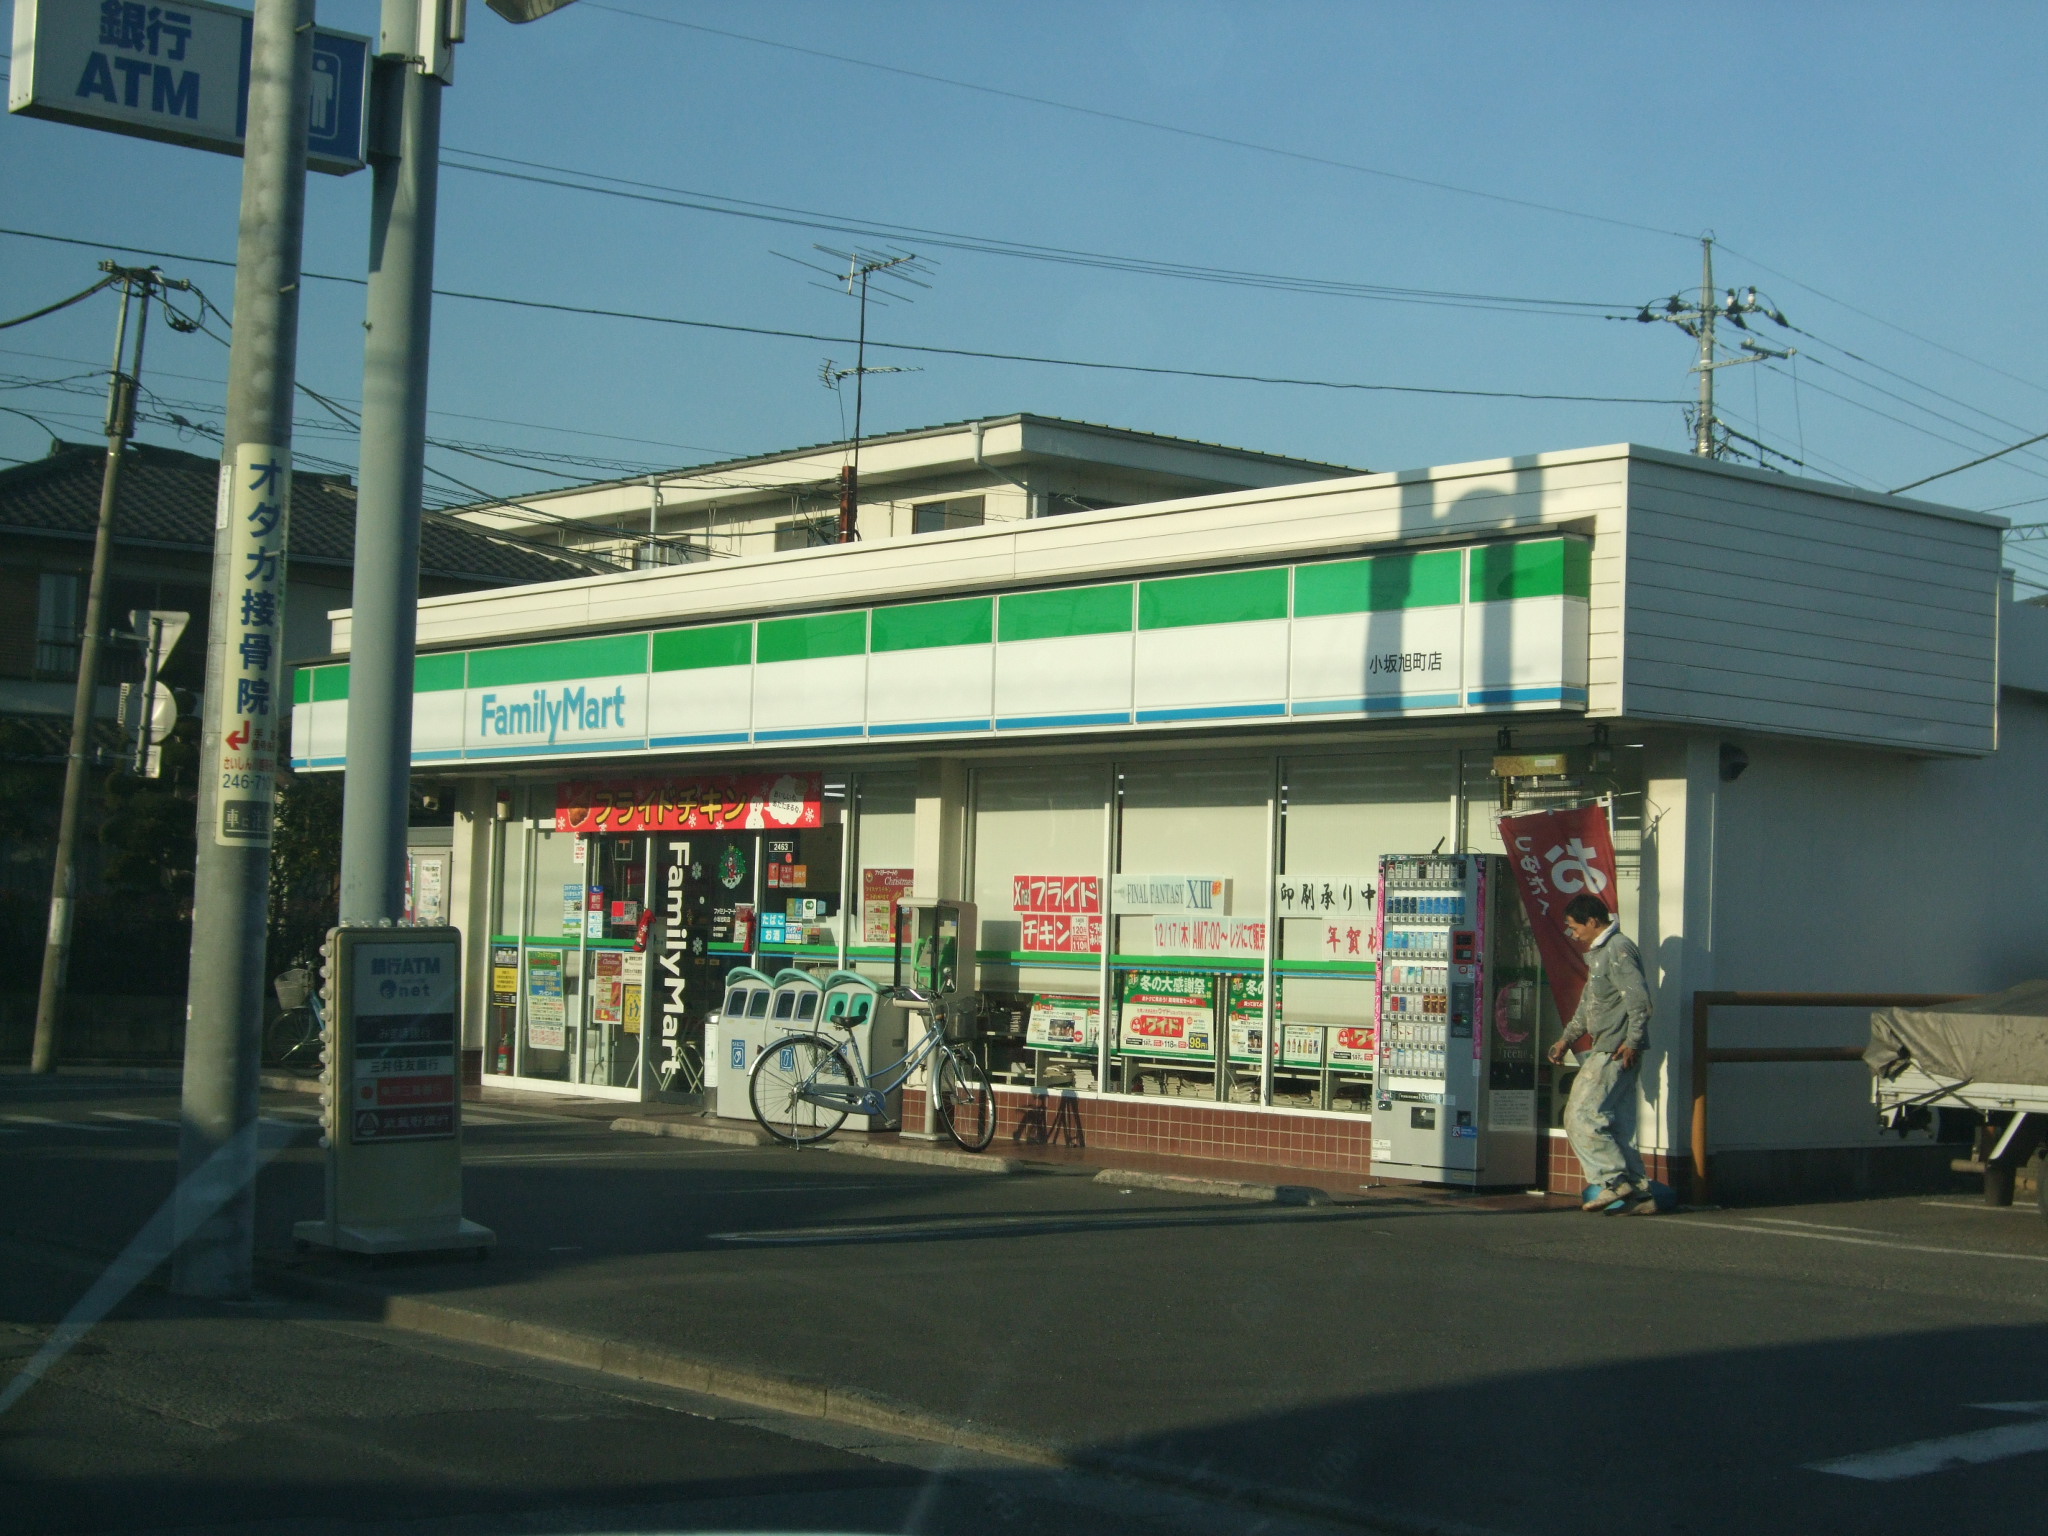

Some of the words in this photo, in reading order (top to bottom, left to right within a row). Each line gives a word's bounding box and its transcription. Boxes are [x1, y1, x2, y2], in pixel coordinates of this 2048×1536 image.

[100, 0, 192, 61] 銀行
[76, 51, 200, 120] ATM
[1369, 652, 1442, 674] 小坂旭町店
[481, 685, 625, 745] FamilyMart
[596, 788, 748, 824] フライドチキン
[1127, 884, 1149, 904] FINAL
[1149, 883, 1184, 904] FANTASY
[1186, 880, 1213, 909] XIII
[1280, 882, 1377, 911] 印刷承り中
[766, 915, 785, 925] たばこ
[1023, 919, 1070, 946] チキン
[769, 930, 785, 941] お酒
[660, 842, 690, 1074] FamilyMart
[1140, 975, 1205, 995] 冬の大感謝祭
[1146, 1017, 1179, 1035] ワイド
[370, 1057, 439, 1074] 三井住友銀行
